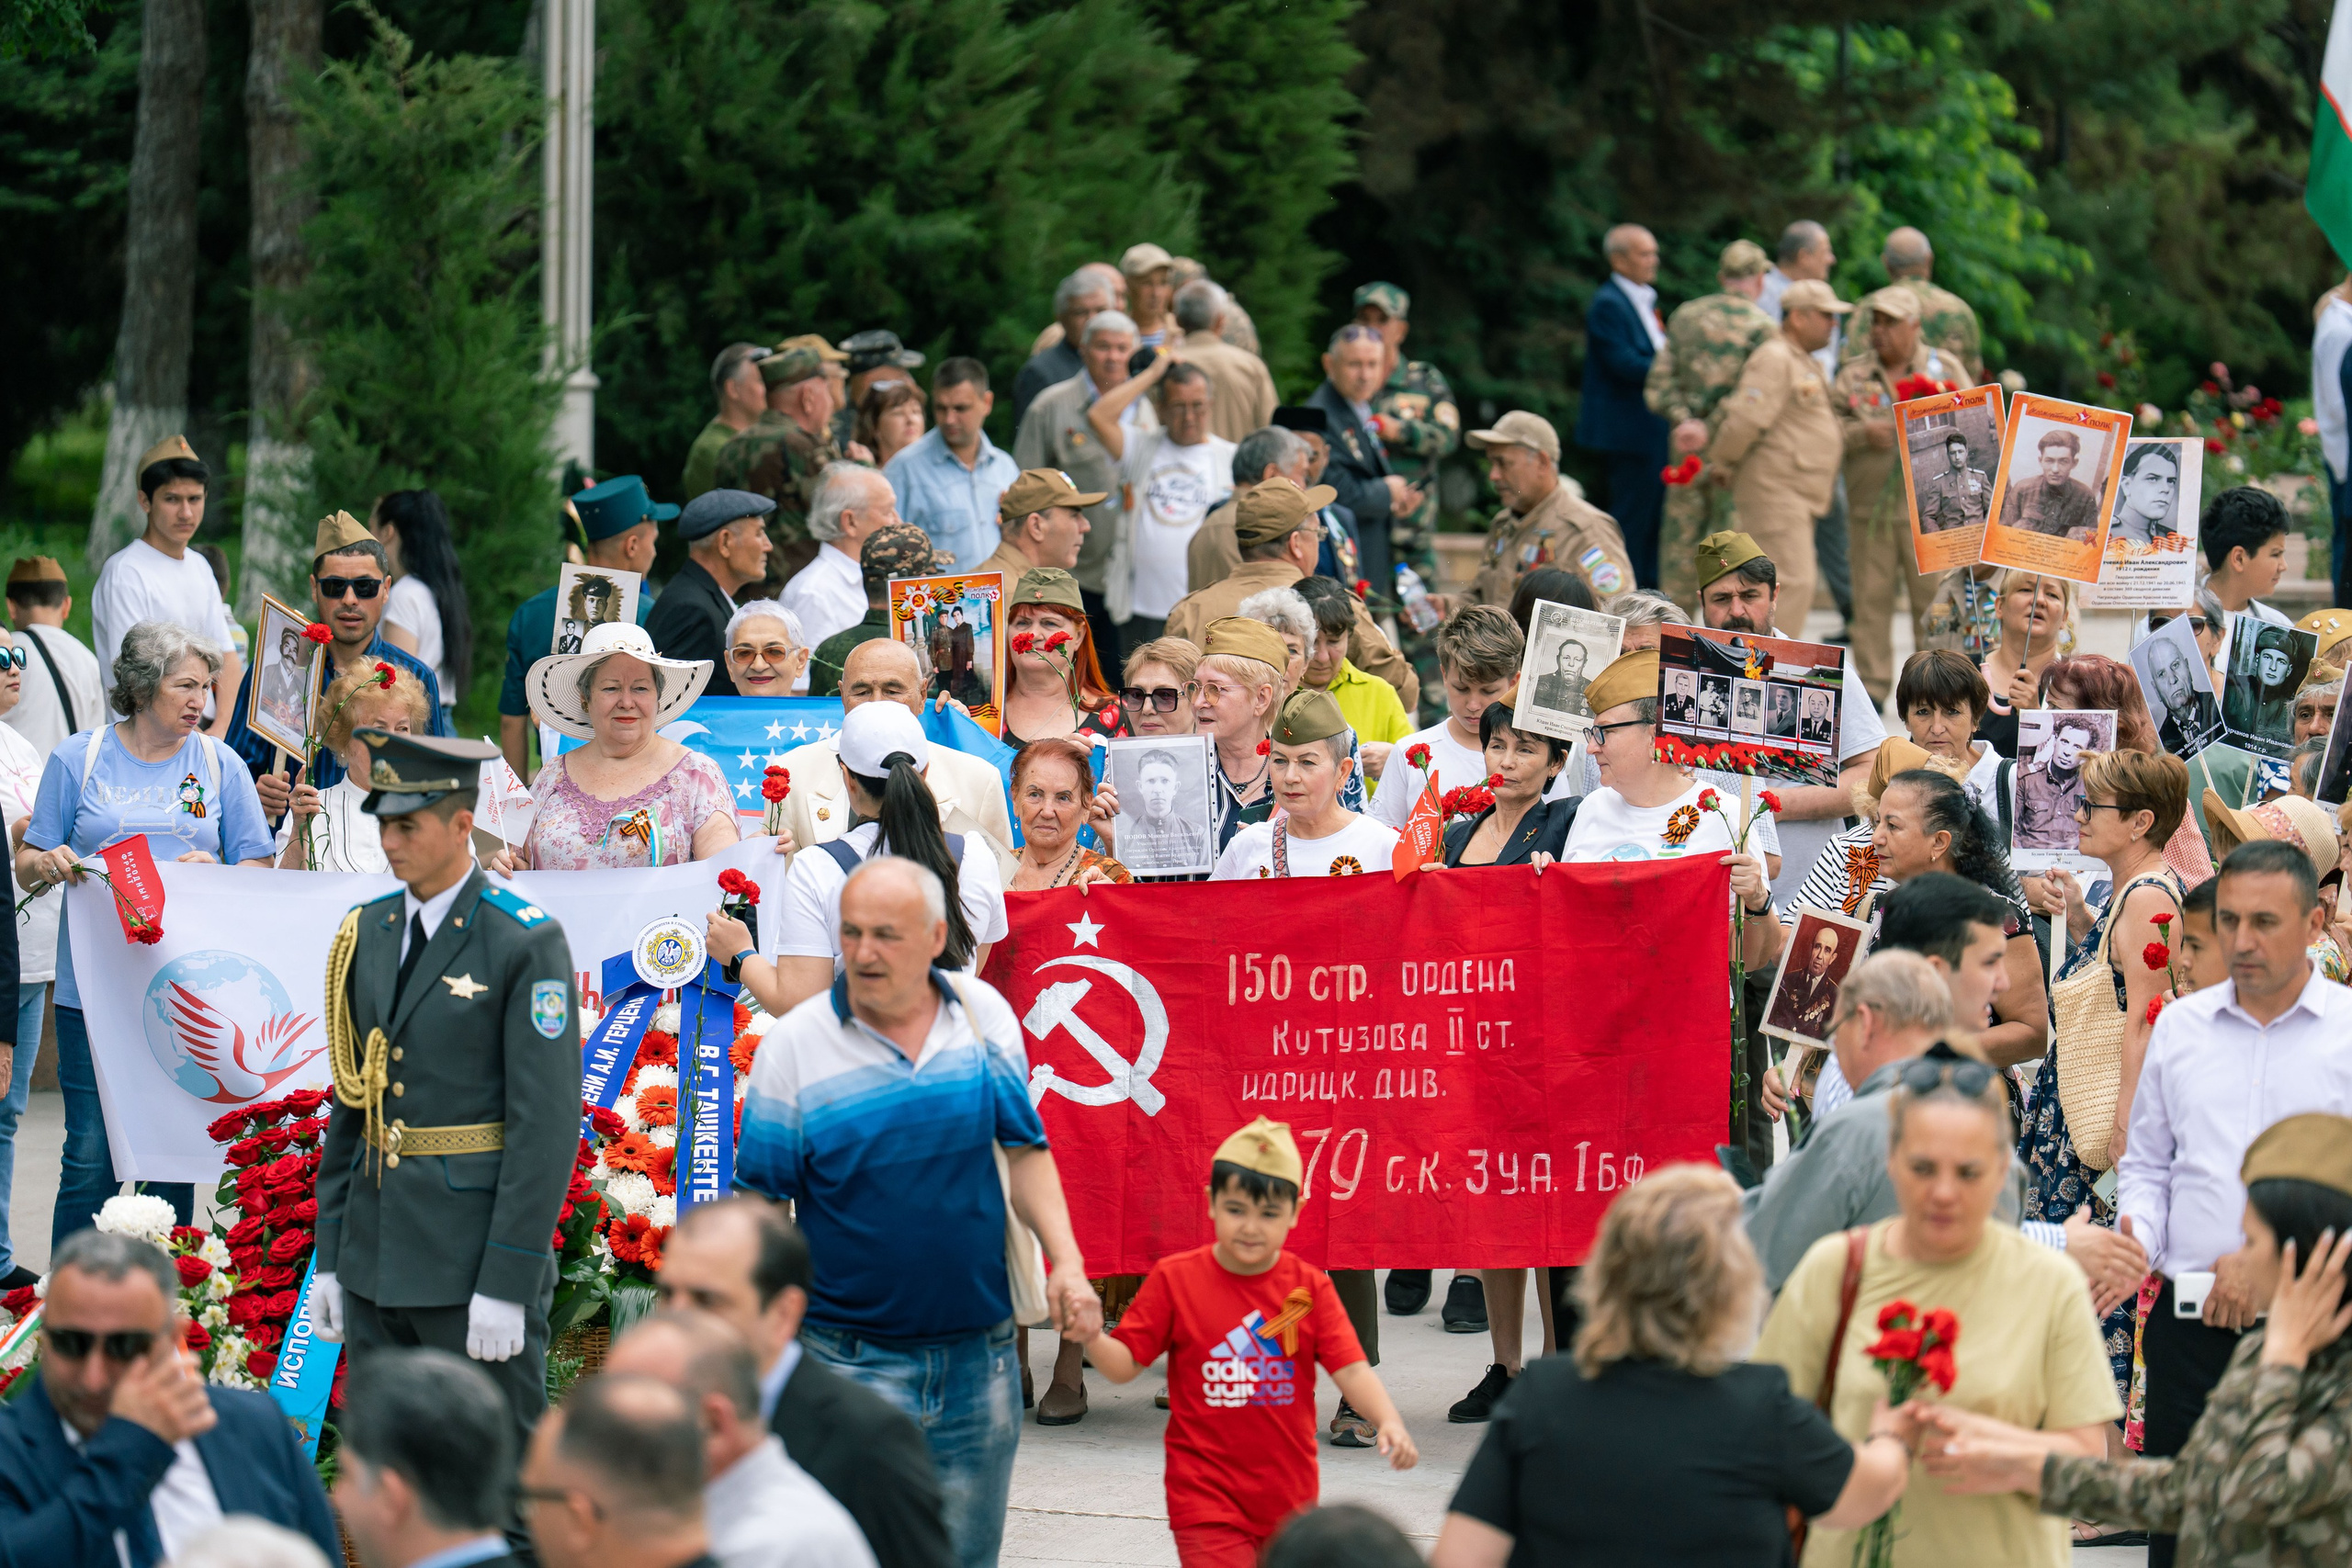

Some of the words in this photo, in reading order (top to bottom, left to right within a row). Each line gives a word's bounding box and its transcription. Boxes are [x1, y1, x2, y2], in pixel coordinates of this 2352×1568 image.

[2245, 742, 2257, 751] 1914
[2250, 733, 2266, 743] Иван
[1415, 824, 1427, 856] ПАМЯТИ
[1422, 821, 1432, 848] ОГОНЬ
[121, 853, 134, 885] ФРОНТ
[127, 851, 151, 900] НАРОДНЫЙ
[1228, 953, 1292, 1005] 150
[1402, 958, 1516, 996] ОРДЕНА
[602, 995, 649, 1045] ГЕРЦЕНА
[590, 1047, 621, 1076] А.И.
[697, 1043, 720, 1058] В
[582, 1073, 608, 1107] ЕНИ
[694, 1088, 719, 1202] ТАШКЕНТЕ
[1300, 1126, 1369, 1201] 79
[1201, 1355, 1295, 1382] adidas
